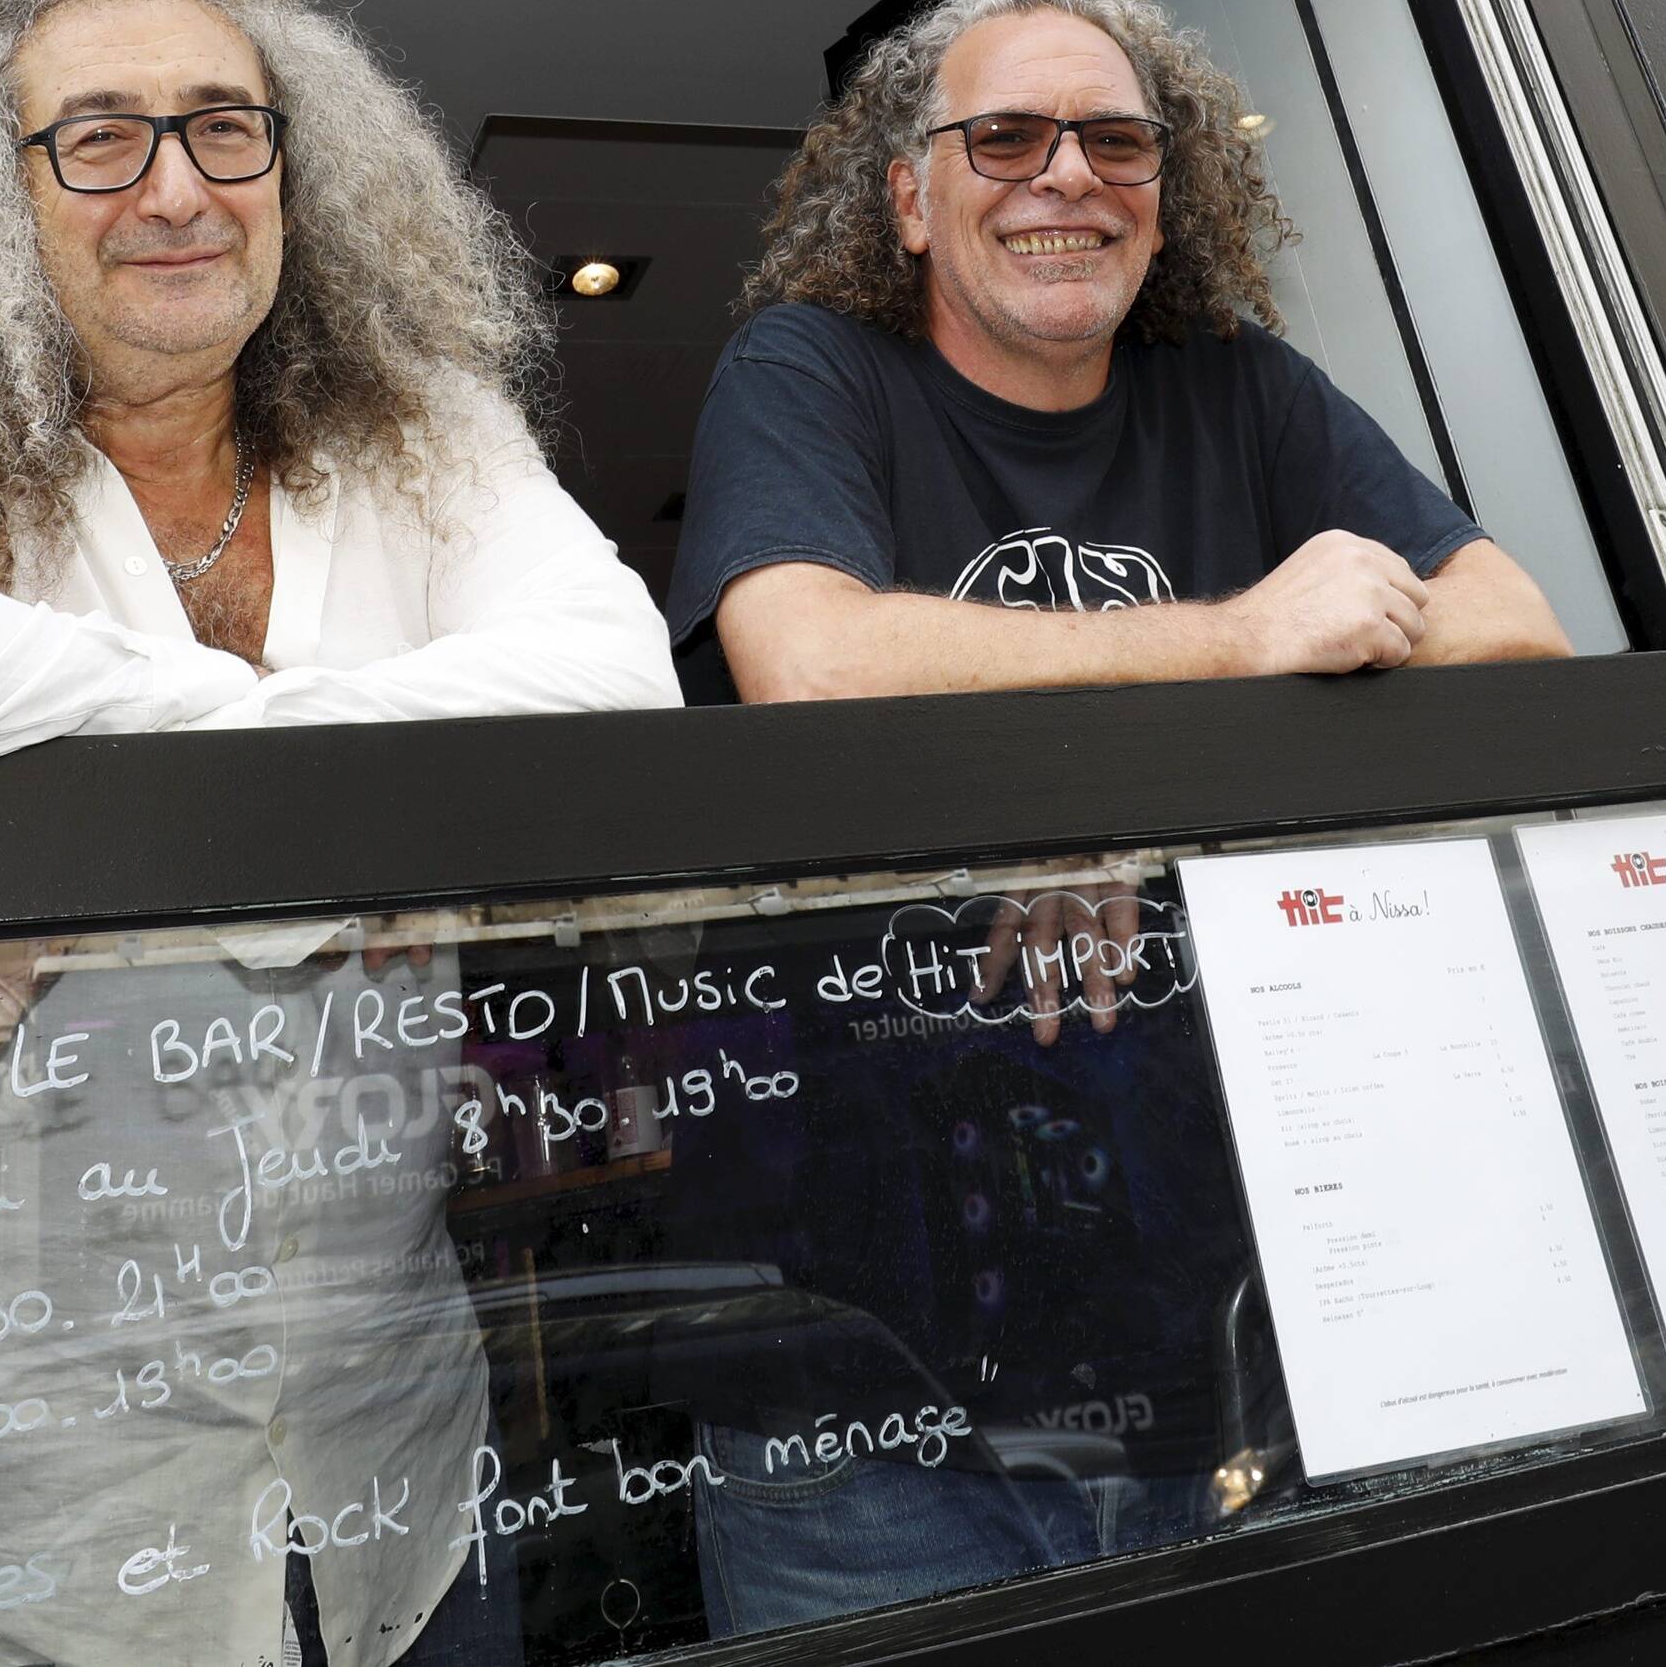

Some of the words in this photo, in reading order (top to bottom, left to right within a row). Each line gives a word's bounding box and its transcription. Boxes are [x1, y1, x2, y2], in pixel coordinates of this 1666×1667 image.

[1349, 905, 1364, 922] à
[1369, 889, 1431, 921] Nissa!
[1249, 985, 1264, 994] NOS
[1268, 982, 1302, 992] ALCOOLS
[10, 1022, 90, 1099] LE
[816, 954, 883, 1002] de
[1634, 1081, 1648, 1090] NOS
[77, 1162, 169, 1202] au
[1294, 1186, 1309, 1196] NOS
[1313, 1182, 1342, 1193] BIERES
[118, 1524, 210, 1595] et
[448, 1443, 589, 1599] font
[616, 1440, 727, 1505] bon
